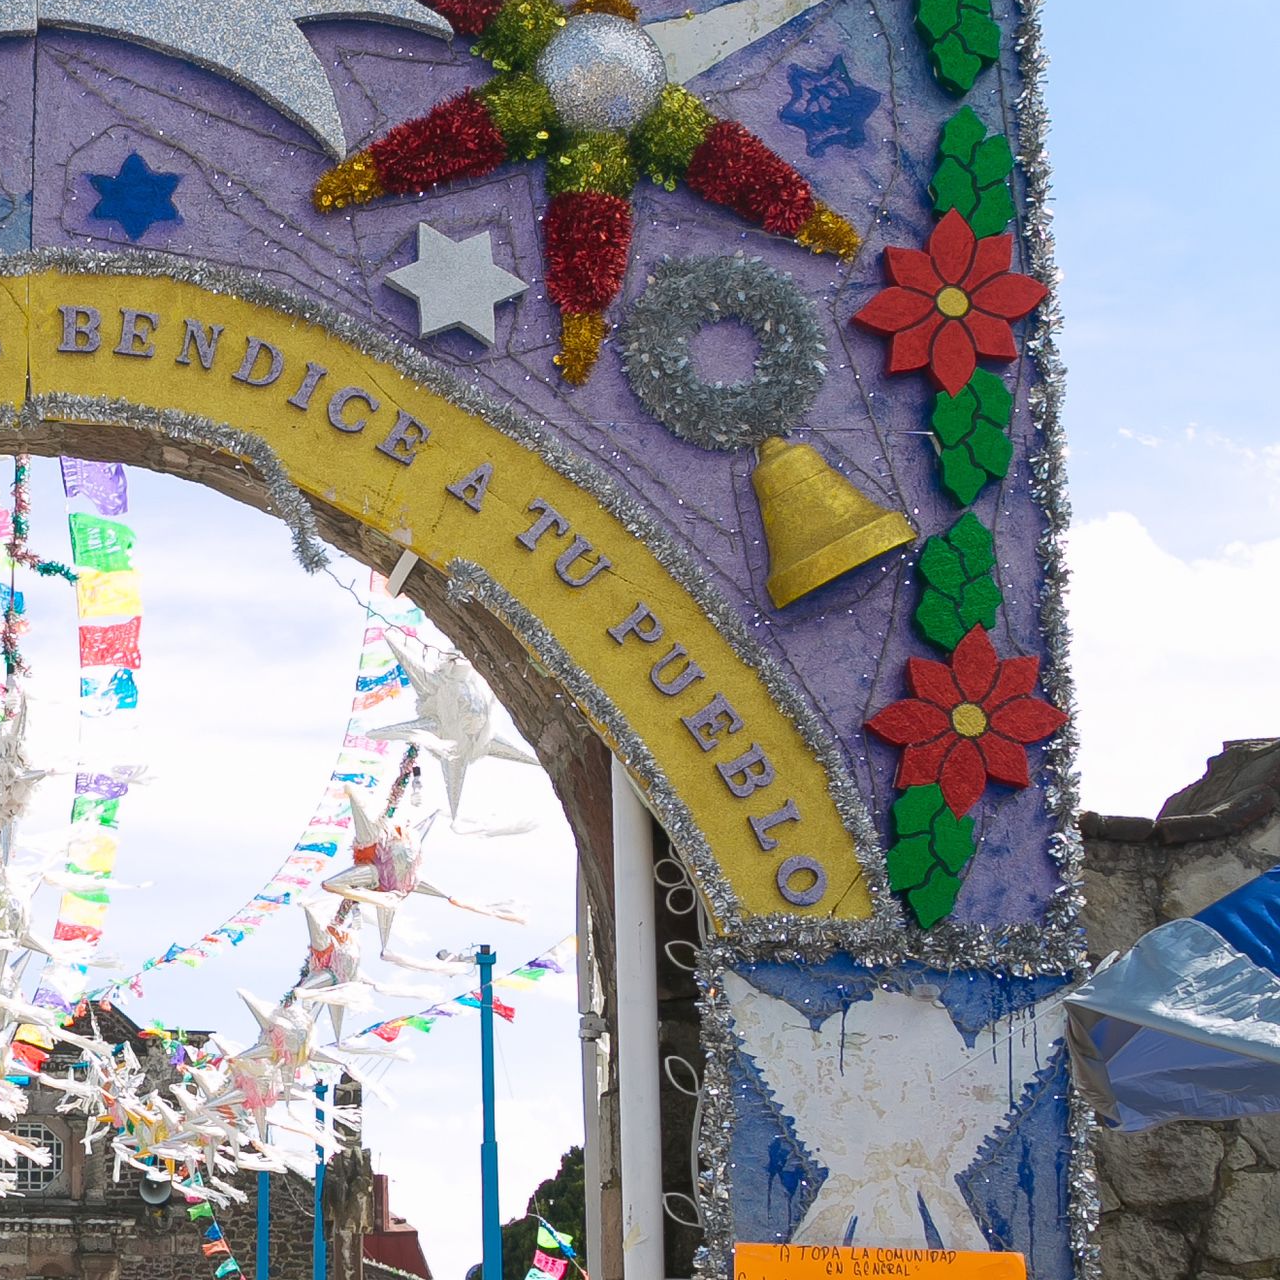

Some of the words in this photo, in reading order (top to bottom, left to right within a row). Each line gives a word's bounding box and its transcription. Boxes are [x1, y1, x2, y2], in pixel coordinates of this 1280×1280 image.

[57, 303, 431, 467] BENDICE
[445, 462, 496, 513] A
[516, 497, 612, 590] TU
[606, 600, 830, 907] PUEBLO
[797, 1245, 840, 1261] TODA
[851, 1247, 869, 1261] LA
[876, 1248, 957, 1264] COMUNIDAD
[826, 1262, 843, 1275] EN
